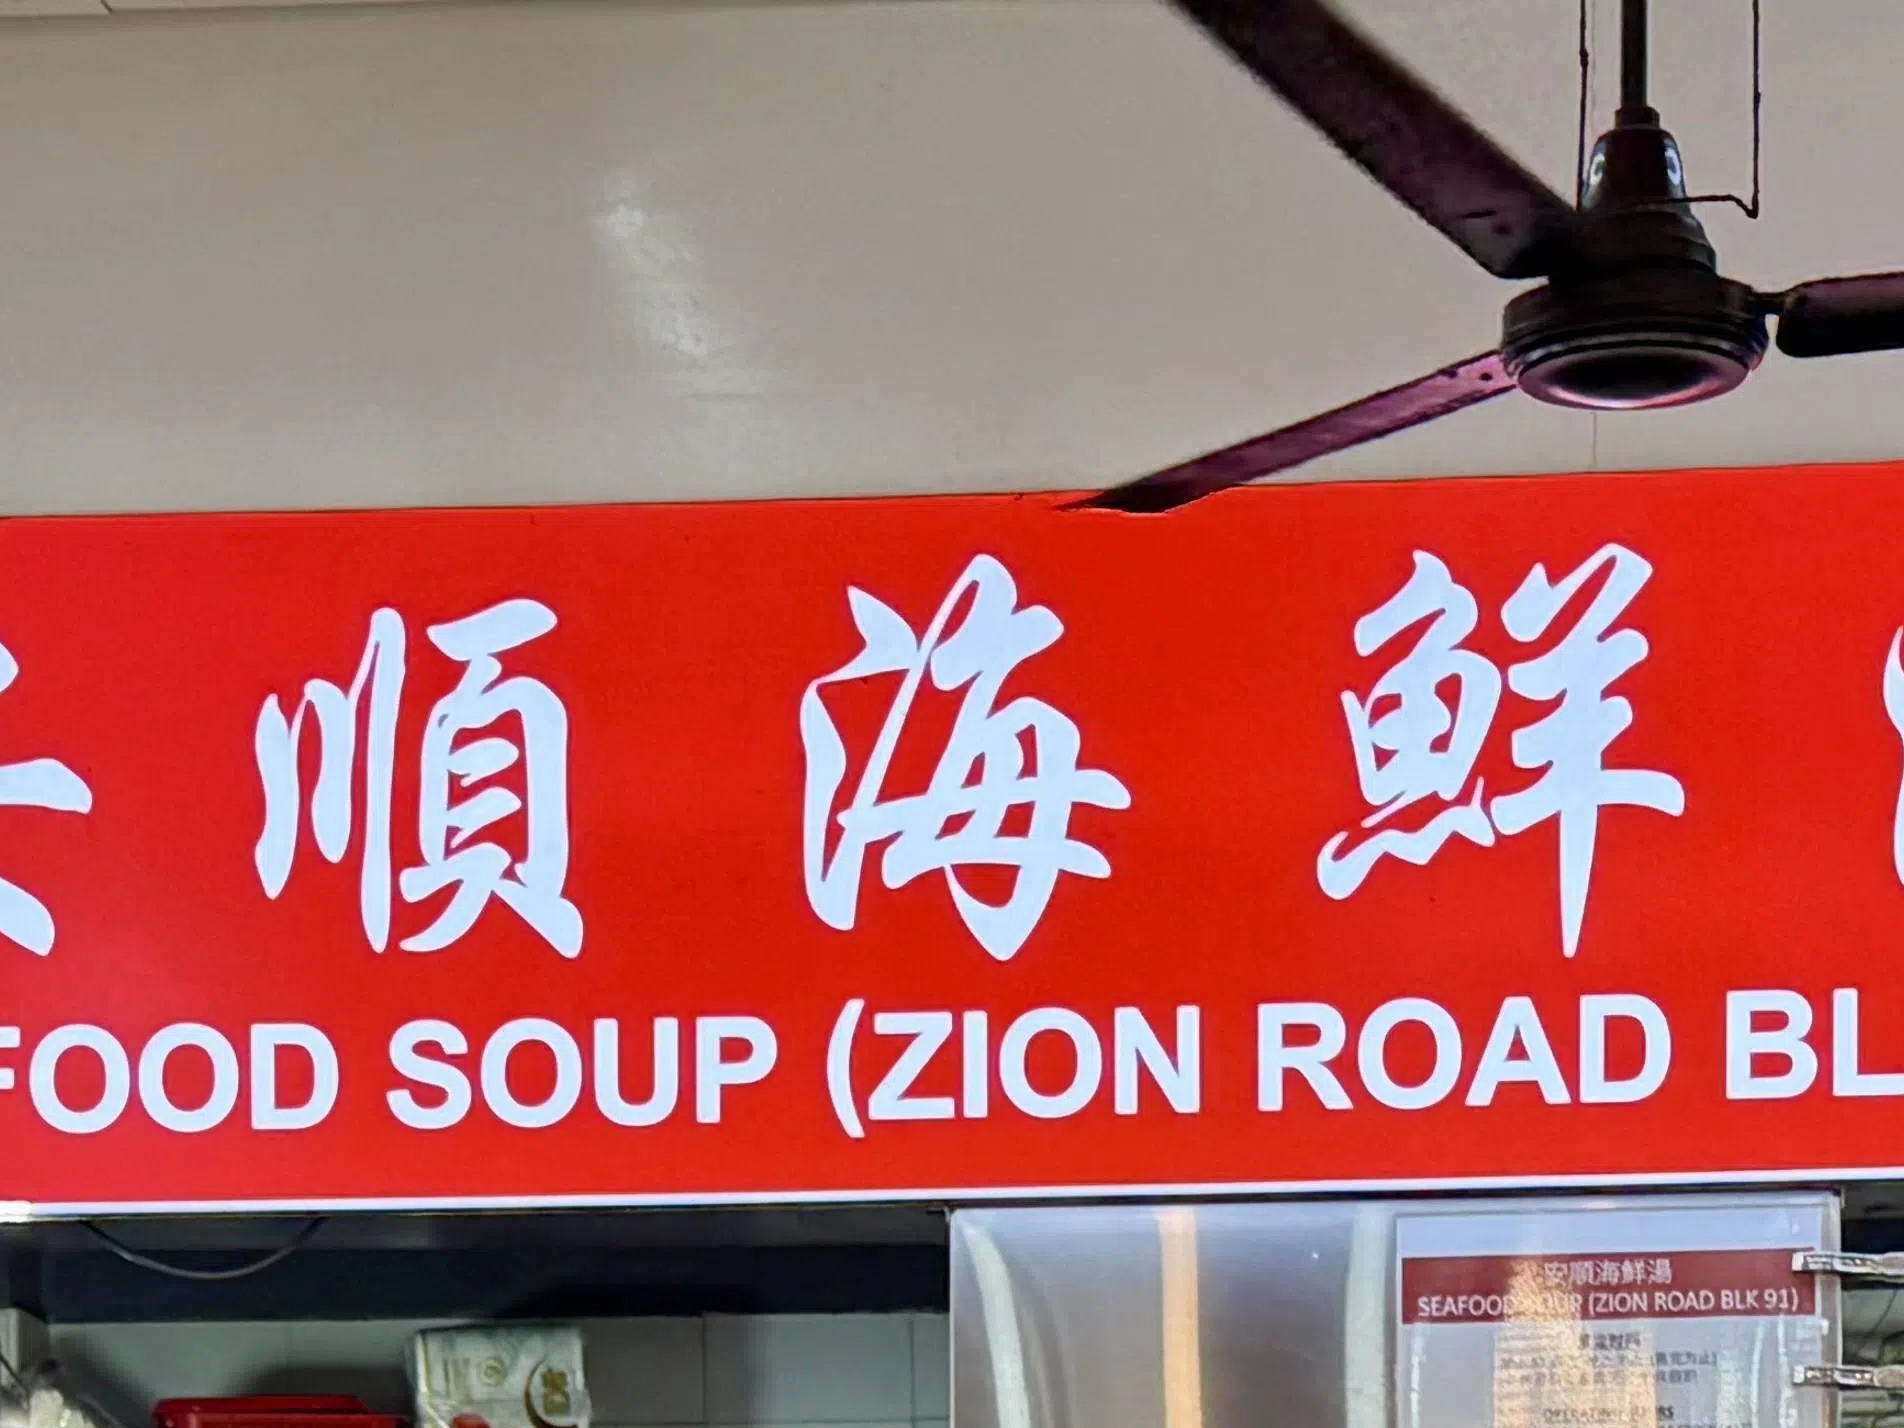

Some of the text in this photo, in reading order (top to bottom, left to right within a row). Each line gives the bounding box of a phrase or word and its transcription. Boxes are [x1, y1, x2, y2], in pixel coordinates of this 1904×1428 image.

[387, 1017, 777, 1129] SOUP
[827, 999, 1200, 1138] (ZION
[1258, 994, 1671, 1111] ROAD
[1654, 1288, 1716, 1312] ROAD
[1721, 1287, 1759, 1310] BLK
[1764, 1286, 1799, 1311] 91)
